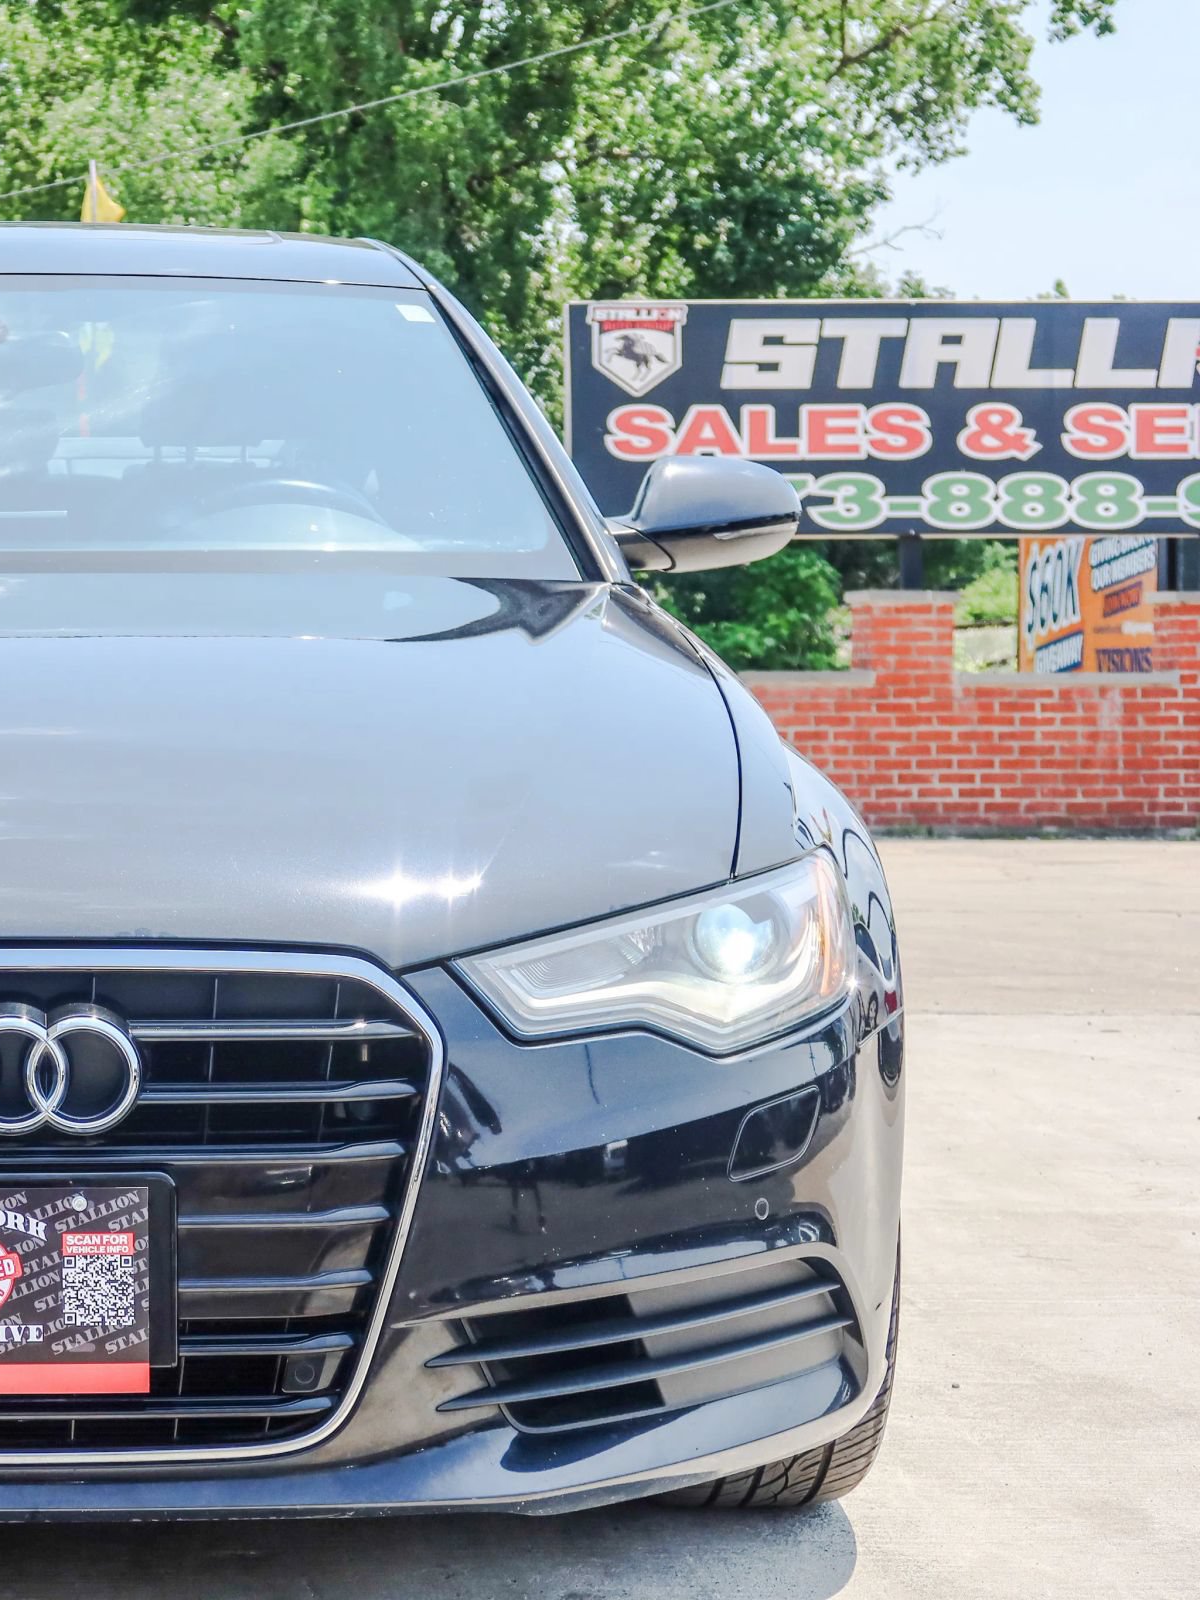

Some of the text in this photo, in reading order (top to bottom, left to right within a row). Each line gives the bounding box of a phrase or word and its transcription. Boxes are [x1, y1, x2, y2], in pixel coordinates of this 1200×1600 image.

[720, 317, 1200, 389] STALLI
[604, 401, 1200, 462] SALES & SE
[54, 1190, 140, 1234] STALLION
[66, 1235, 102, 1245] SCAN
[104, 1235, 128, 1245] FOR
[66, 1246, 129, 1254] VEHICLE INFO
